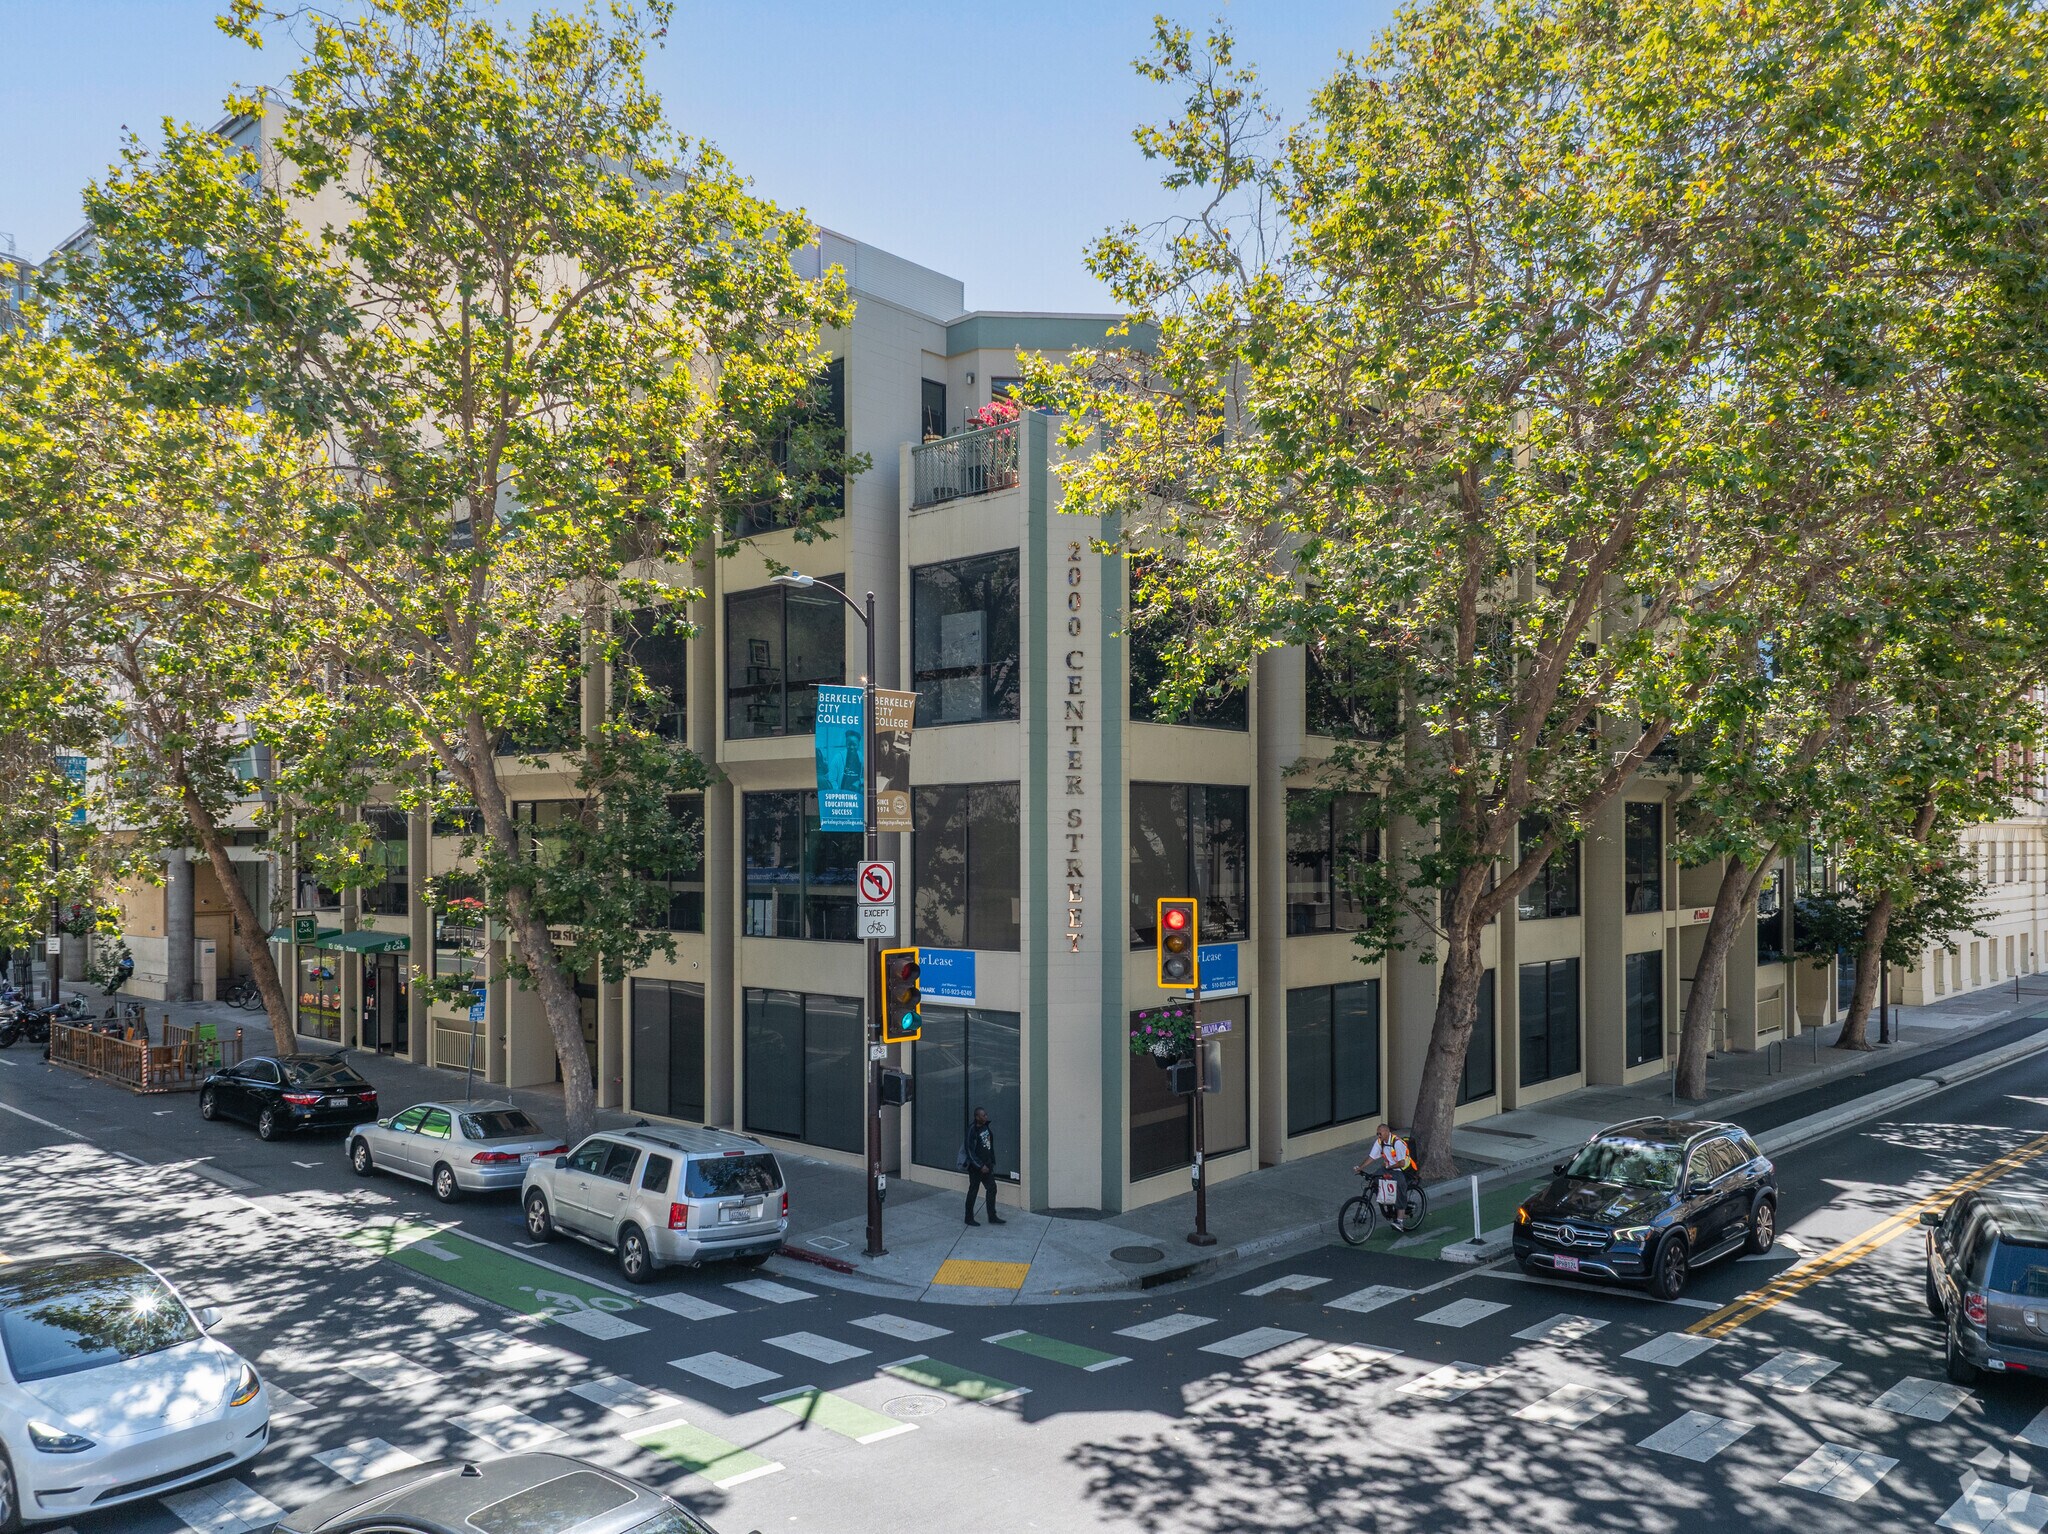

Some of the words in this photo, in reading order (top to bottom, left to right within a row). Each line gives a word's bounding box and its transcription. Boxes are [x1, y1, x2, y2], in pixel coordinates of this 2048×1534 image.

[1067, 541, 1082, 637] 2000
[819, 693, 862, 704] BERKELEY
[875, 696, 914, 708] BERKELEY
[818, 703, 840, 713] CITY
[875, 706, 893, 716] CITY
[817, 714, 859, 725] COLLEGE
[1065, 650, 1085, 796] CENTER
[825, 800, 858, 808] EDUCATIONAL
[1065, 808, 1084, 954] STREET
[864, 909, 889, 917] EXCEPT
[928, 954, 954, 966] Lease
[1202, 951, 1222, 962] Lease
